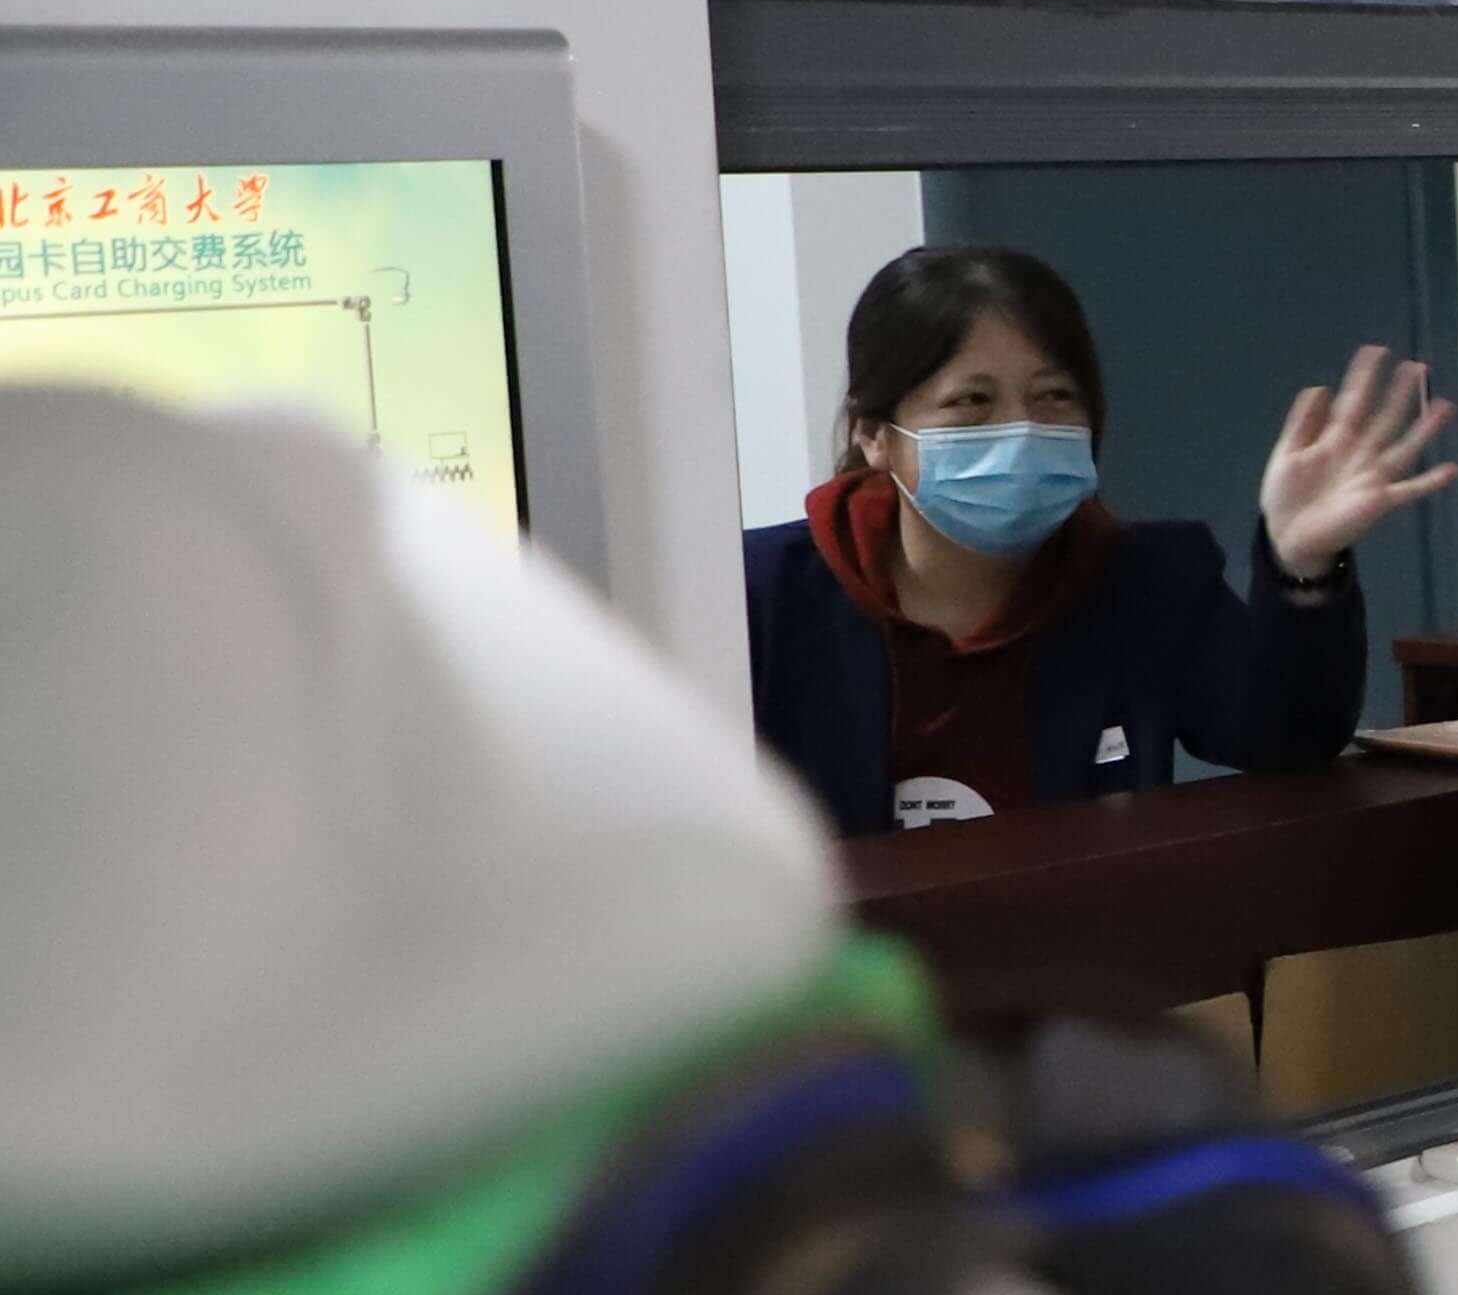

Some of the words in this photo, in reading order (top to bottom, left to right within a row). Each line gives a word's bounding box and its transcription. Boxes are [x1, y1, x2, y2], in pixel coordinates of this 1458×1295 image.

[53, 280, 108, 301] Card
[117, 274, 224, 301] Charging
[231, 273, 312, 297] System
